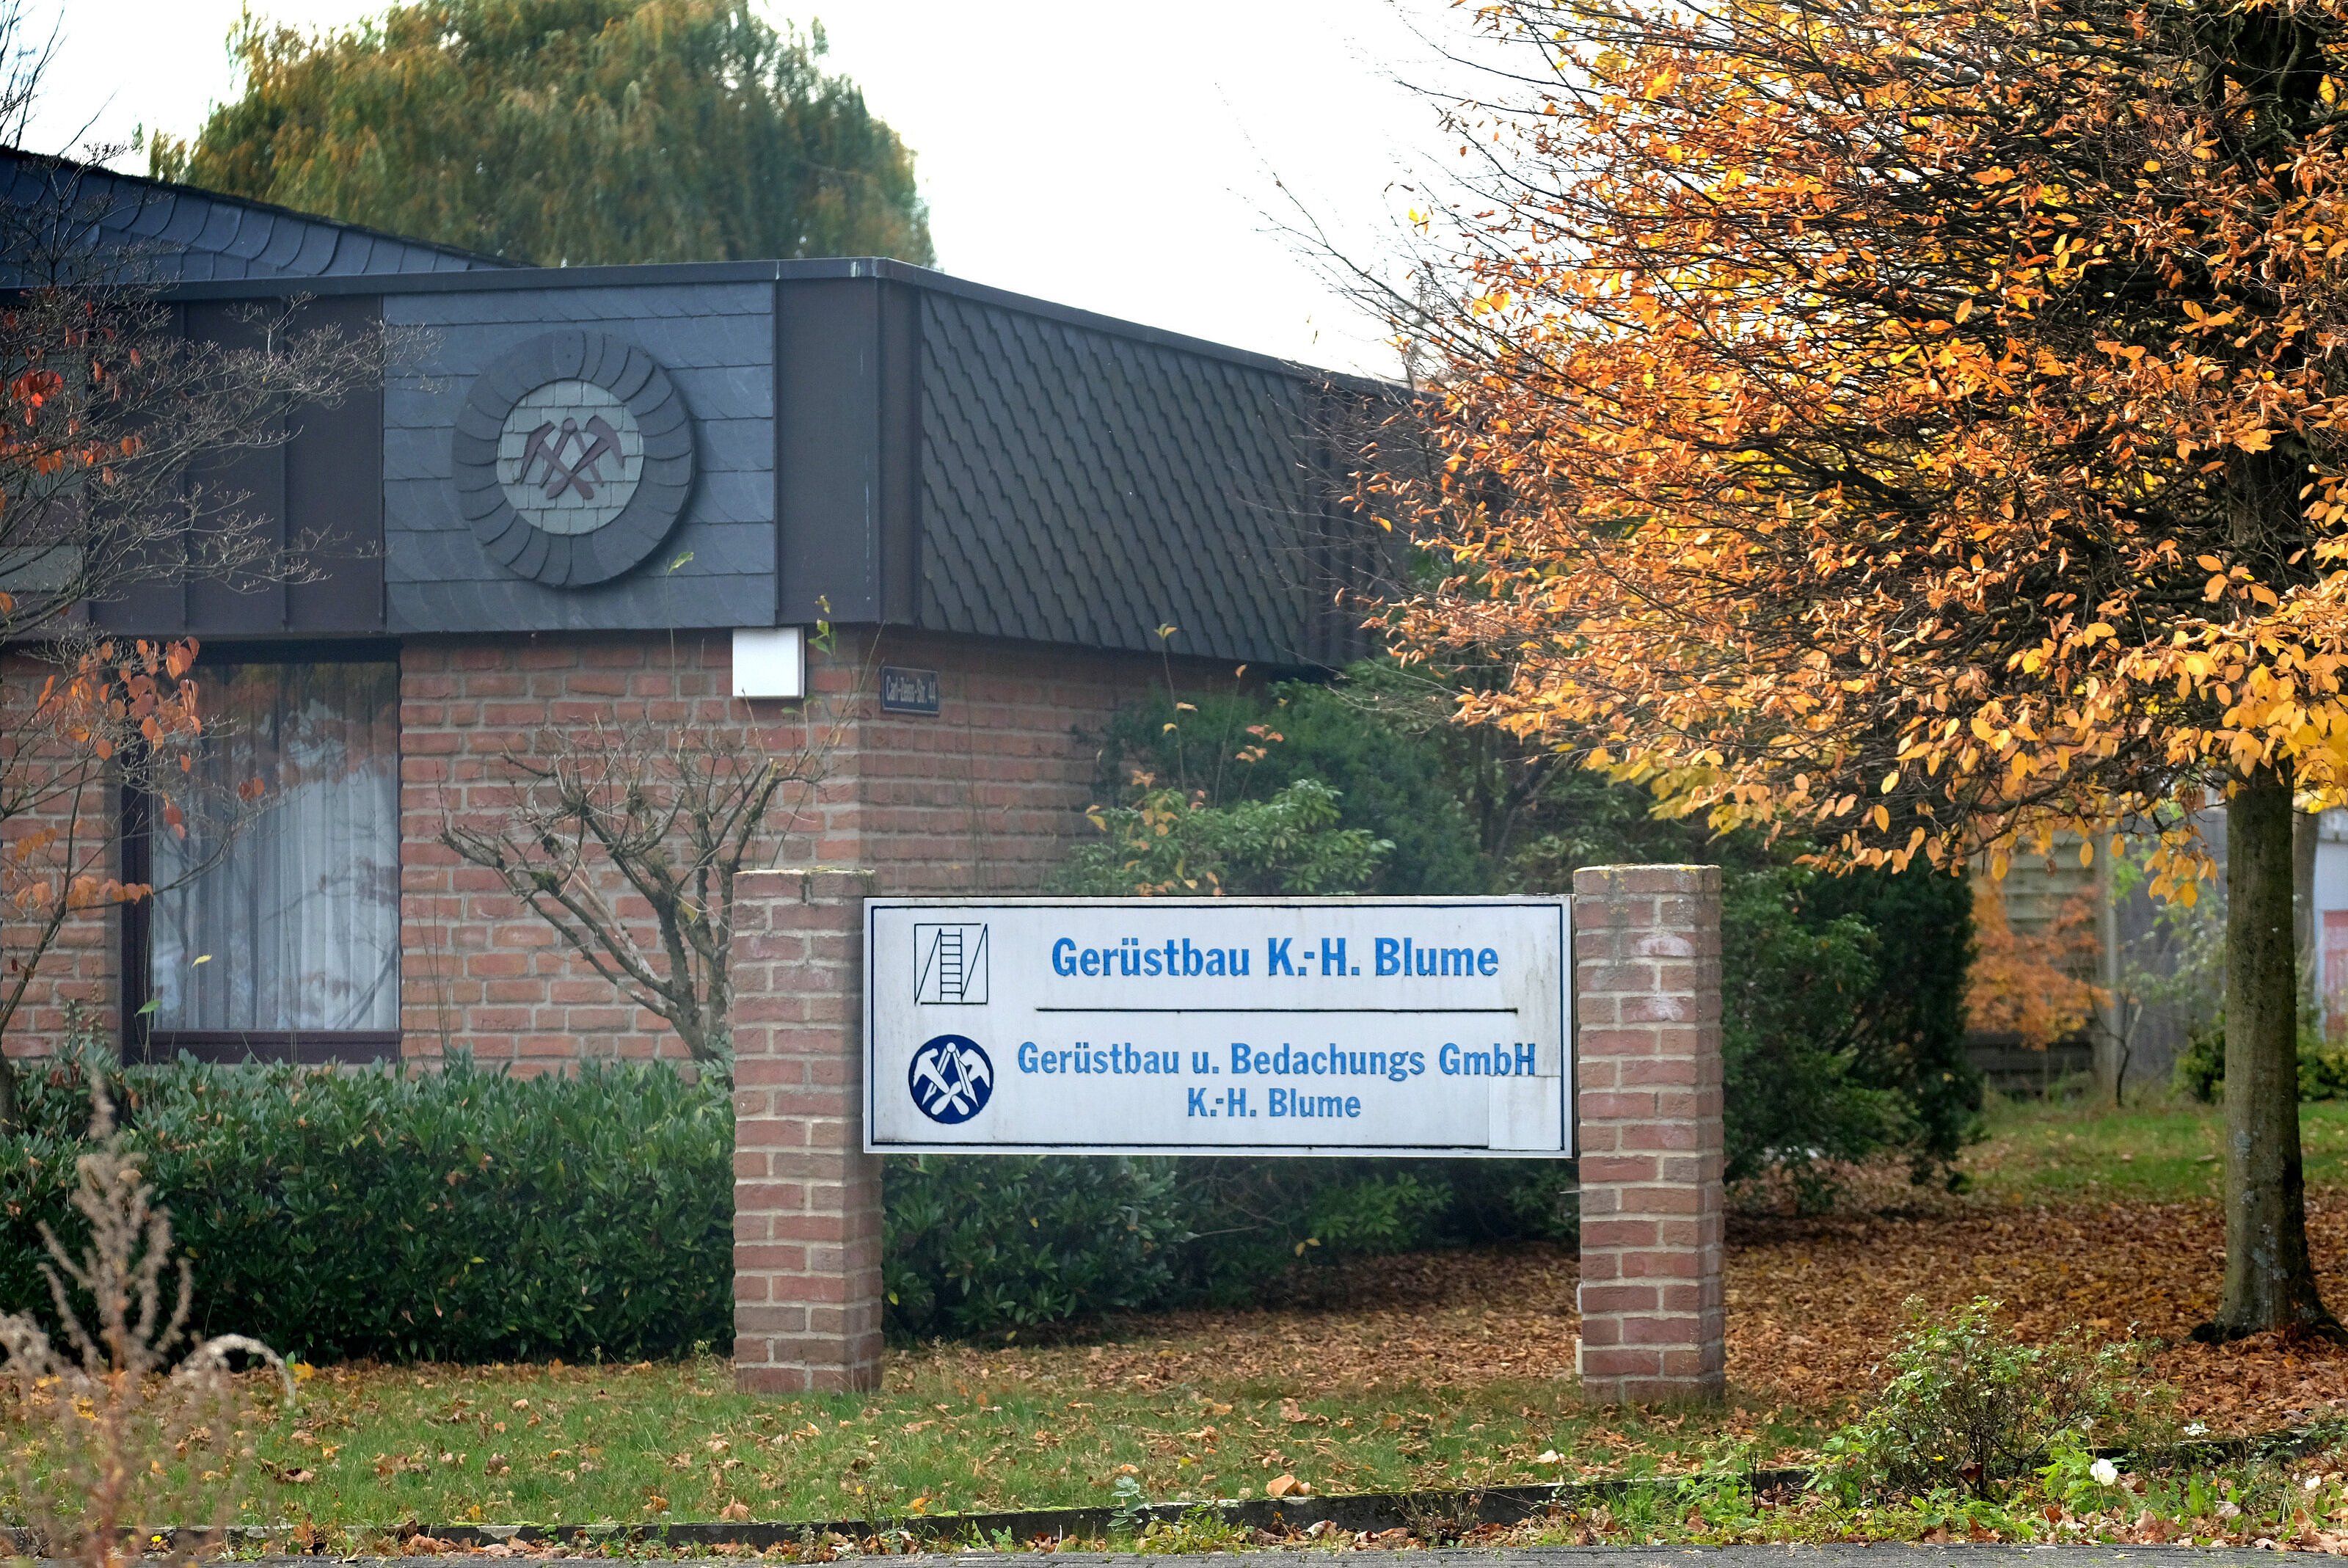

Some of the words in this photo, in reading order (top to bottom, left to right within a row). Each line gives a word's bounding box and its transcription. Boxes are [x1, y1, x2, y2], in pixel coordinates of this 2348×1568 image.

[1051, 937, 1250, 977] Gerüstbau
[1267, 936, 1362, 977] K.-H.
[1374, 936, 1499, 977] Blume
[1017, 1041, 1180, 1076] Gerüstbau
[1191, 1050, 1220, 1075] u.
[1230, 1042, 1426, 1082] Bedachungs
[1438, 1043, 1536, 1076] GmbH
[1186, 1087, 1257, 1118] K.-H.
[1267, 1087, 1362, 1118] Blume
